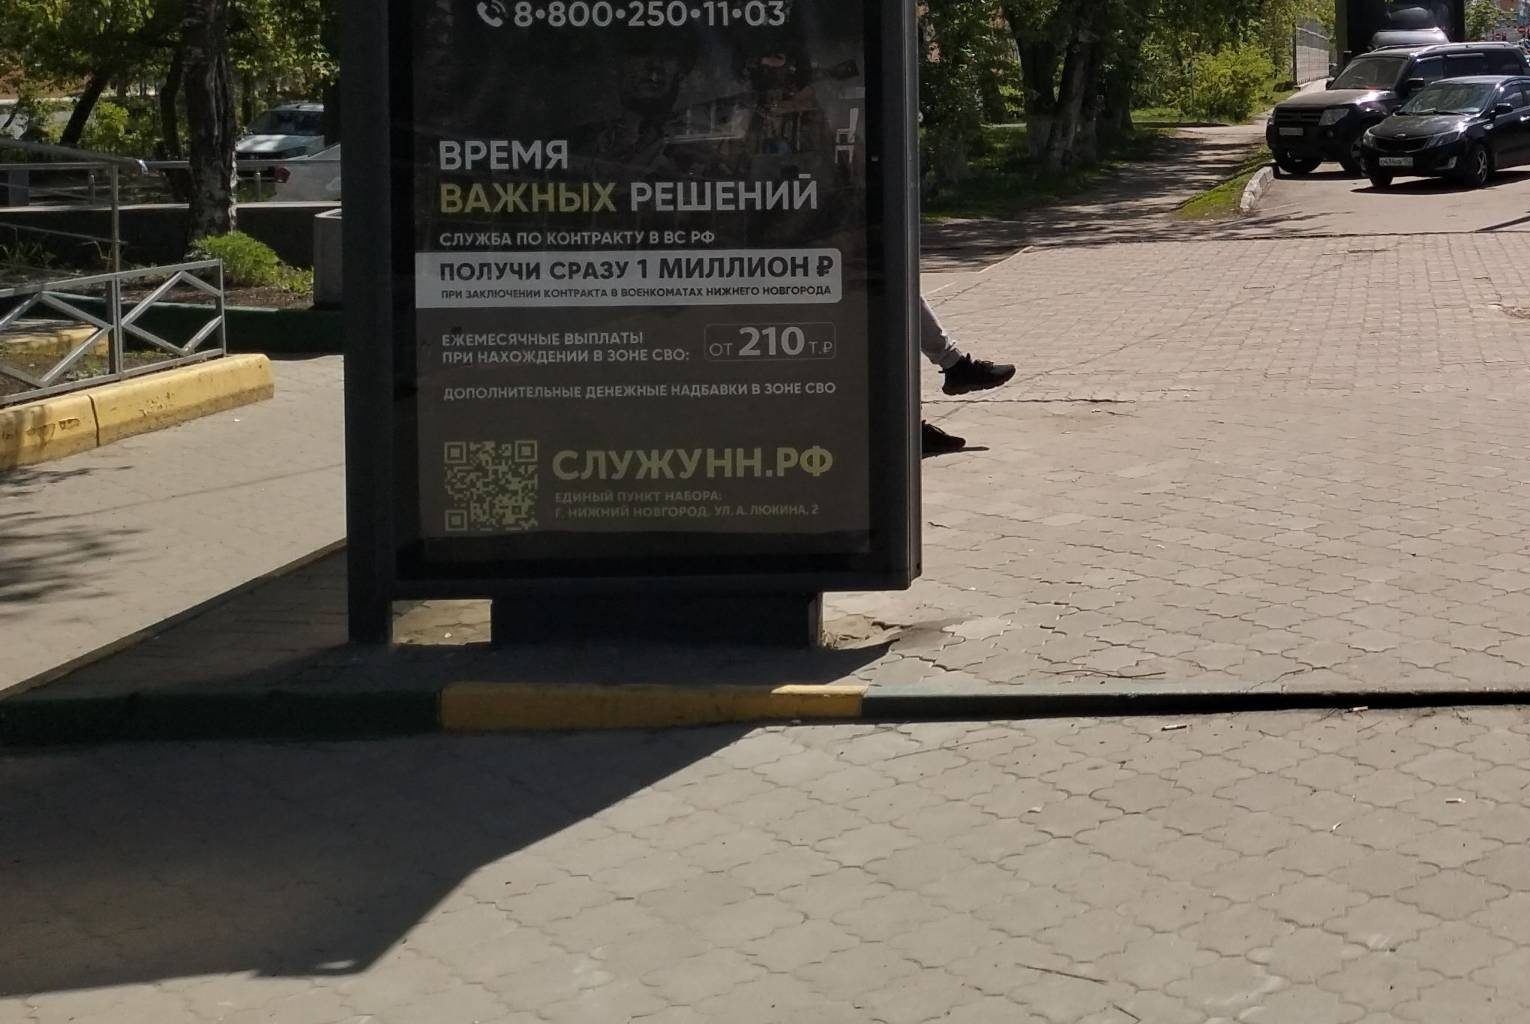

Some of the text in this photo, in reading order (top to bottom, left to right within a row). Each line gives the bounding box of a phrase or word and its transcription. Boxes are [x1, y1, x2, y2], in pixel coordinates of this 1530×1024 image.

[439, 139, 569, 171] ВРЕМЯ
[440, 174, 818, 214] ВАЖНЫХ РЕШЕНИЙ
[439, 229, 715, 246] СЛУЖБА ПО КОНТРАКТУ В ВС РФ
[439, 262, 542, 282] ПОЛУЧИ
[549, 260, 629, 281] СРАЗУ
[637, 259, 648, 279] 1
[658, 256, 809, 279] МИЛЛИОН
[441, 285, 833, 299] ПРИ ЗАКЛЮЧЕНИИ КОНТРАКТА В ВОЕНКОМАТАХ НИЖНЕГО НОВГОРОДА
[442, 332, 643, 346] ЕЖЕМЕСЯЧНЫЕ ВЫПЛАТЫ
[709, 342, 733, 356] ОТ
[738, 326, 805, 356] 210
[442, 349, 690, 364] ПРИ НАХОЖДЕНИИ В ЗОНЕ СВО:
[443, 382, 836, 401] ДОПОЛНИТЕЛЬНЫЕ ДЕНЕЖНЫЕ НАДБАВКИ В ЗОНЕ СВО
[551, 445, 834, 480] СЛУЖУНН.РФ
[555, 490, 723, 504] ЕДИНЫЙ ПУНКТ НАБОРА:
[568, 505, 629, 518] НИЖНИЙ
[811, 503, 820, 514] 2
